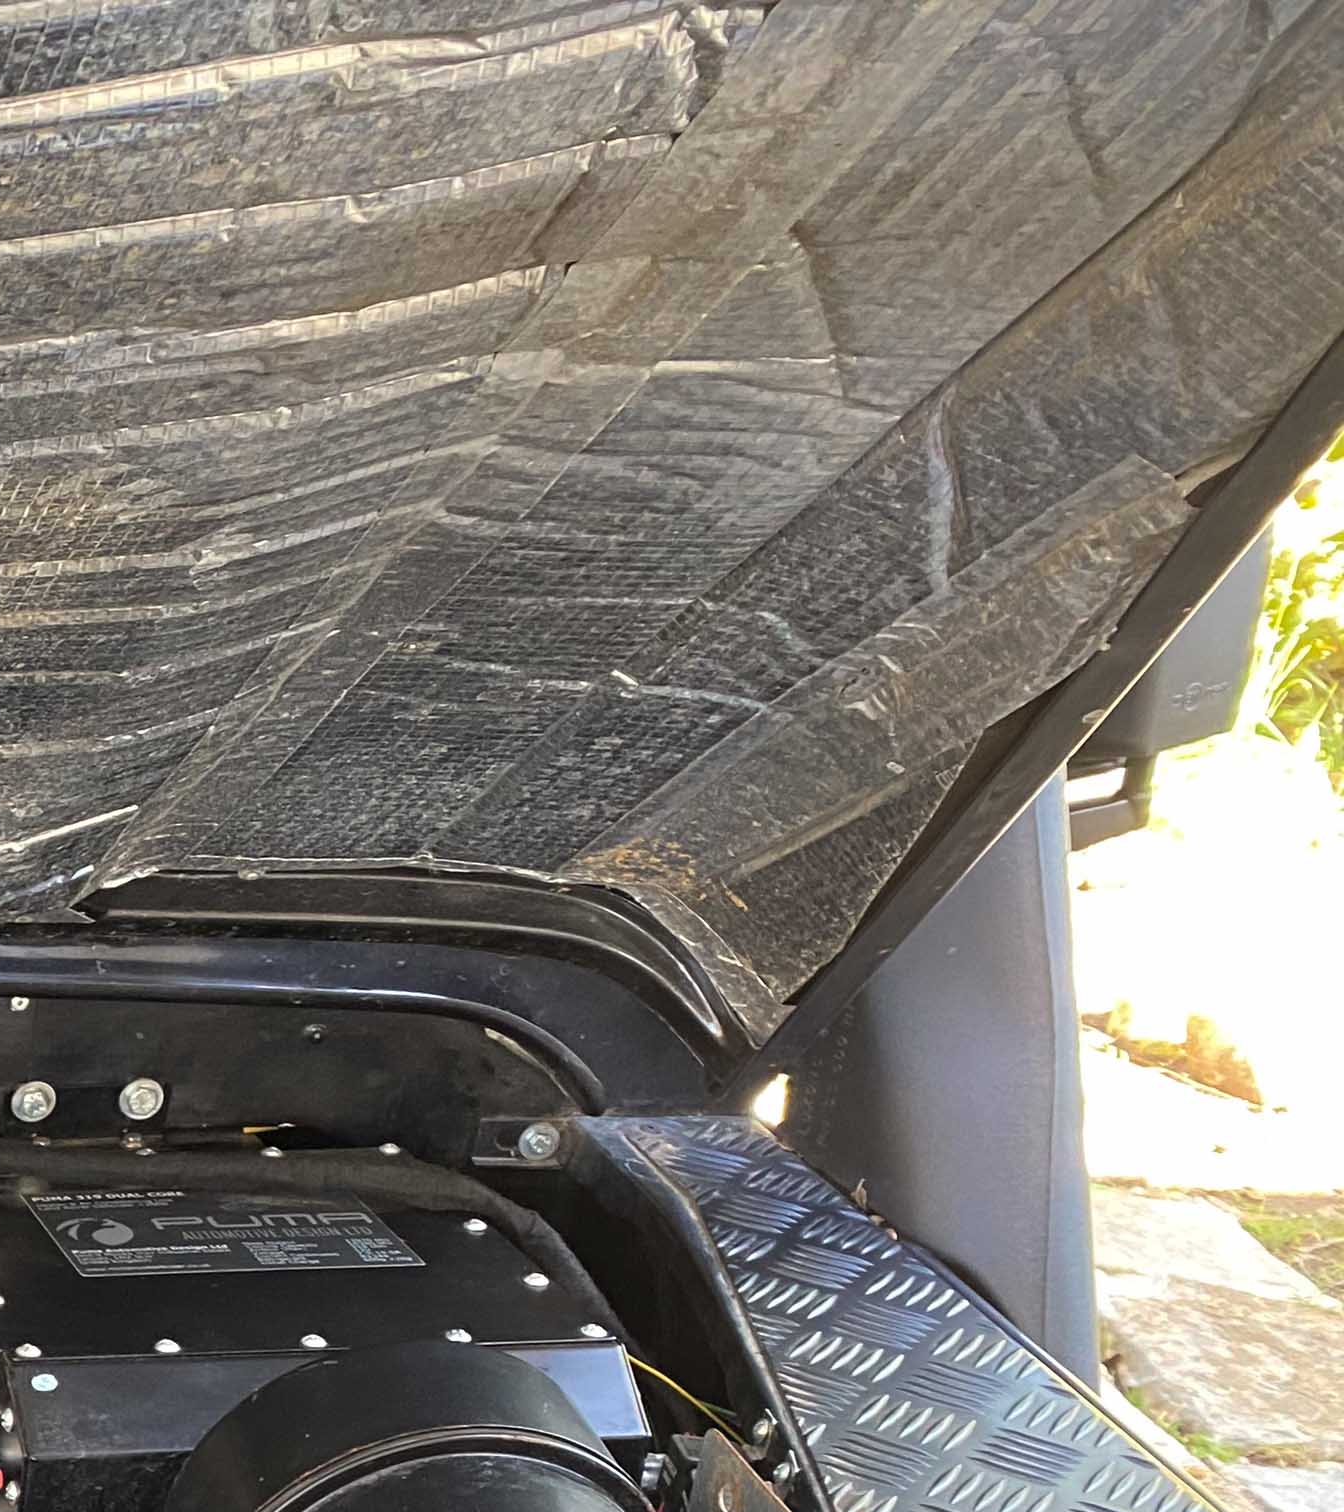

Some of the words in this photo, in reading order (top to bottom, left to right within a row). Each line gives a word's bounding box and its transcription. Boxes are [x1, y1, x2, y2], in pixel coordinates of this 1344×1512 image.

[150, 1211, 374, 1230] PUMA
[181, 1228, 279, 1241] AUTOMOTIVE
[281, 1227, 340, 1240] DESIGN
[343, 1225, 373, 1237] LTD
